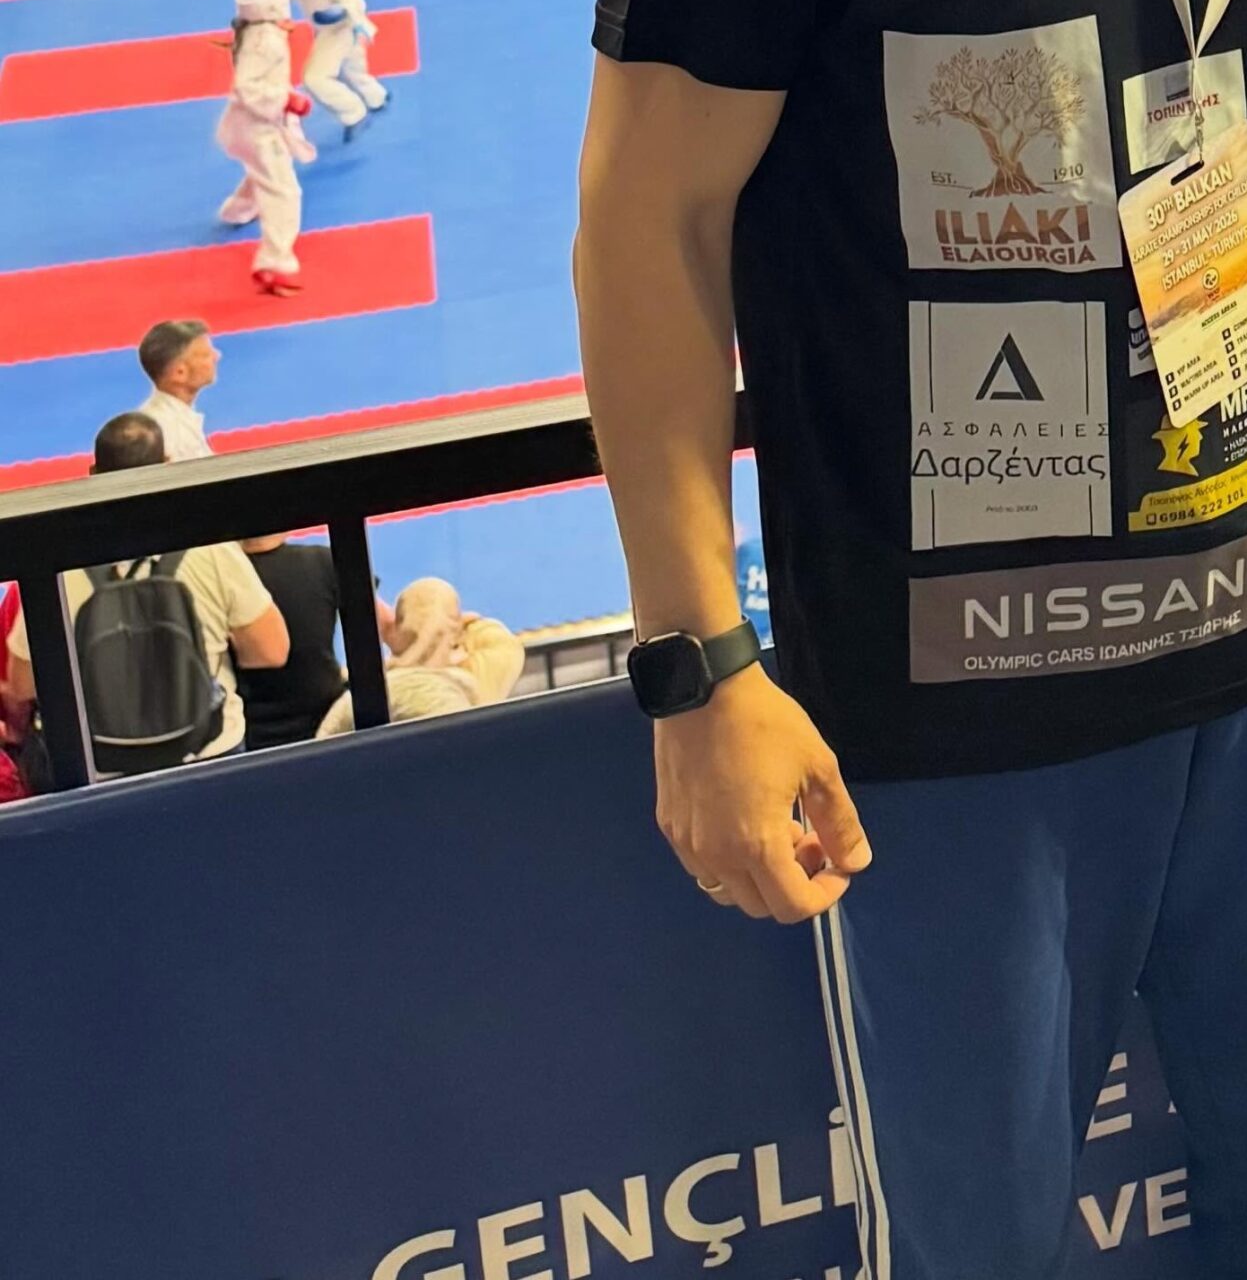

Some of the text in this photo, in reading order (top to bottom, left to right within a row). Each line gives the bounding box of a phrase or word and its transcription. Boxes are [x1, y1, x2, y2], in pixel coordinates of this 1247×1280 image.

[930, 171, 958, 185] EST.
[1053, 164, 1084, 182] 1910
[1174, 162, 1234, 213] BALKAN
[935, 202, 1092, 246] ILIAKI
[941, 245, 1097, 267] ELAIOURGIA
[1162, 249, 1176, 267] 29
[1181, 241, 1192, 256] 31
[1192, 227, 1214, 249] MAY
[917, 422, 1109, 438] ΑΣΦΑΛΕΙΕΣ
[911, 446, 1106, 485] Δαρζέντας
[1159, 507, 1196, 522] 6984
[1201, 500, 1224, 516] 222
[1227, 488, 1245, 505] 101
[964, 558, 1245, 639] NISSAN
[964, 610, 1242, 671] OLYMPIC CARS ΙΩΑΝΝΗΣ ΤΣΙΩΡΗΣ
[1078, 1167, 1191, 1251] VE
